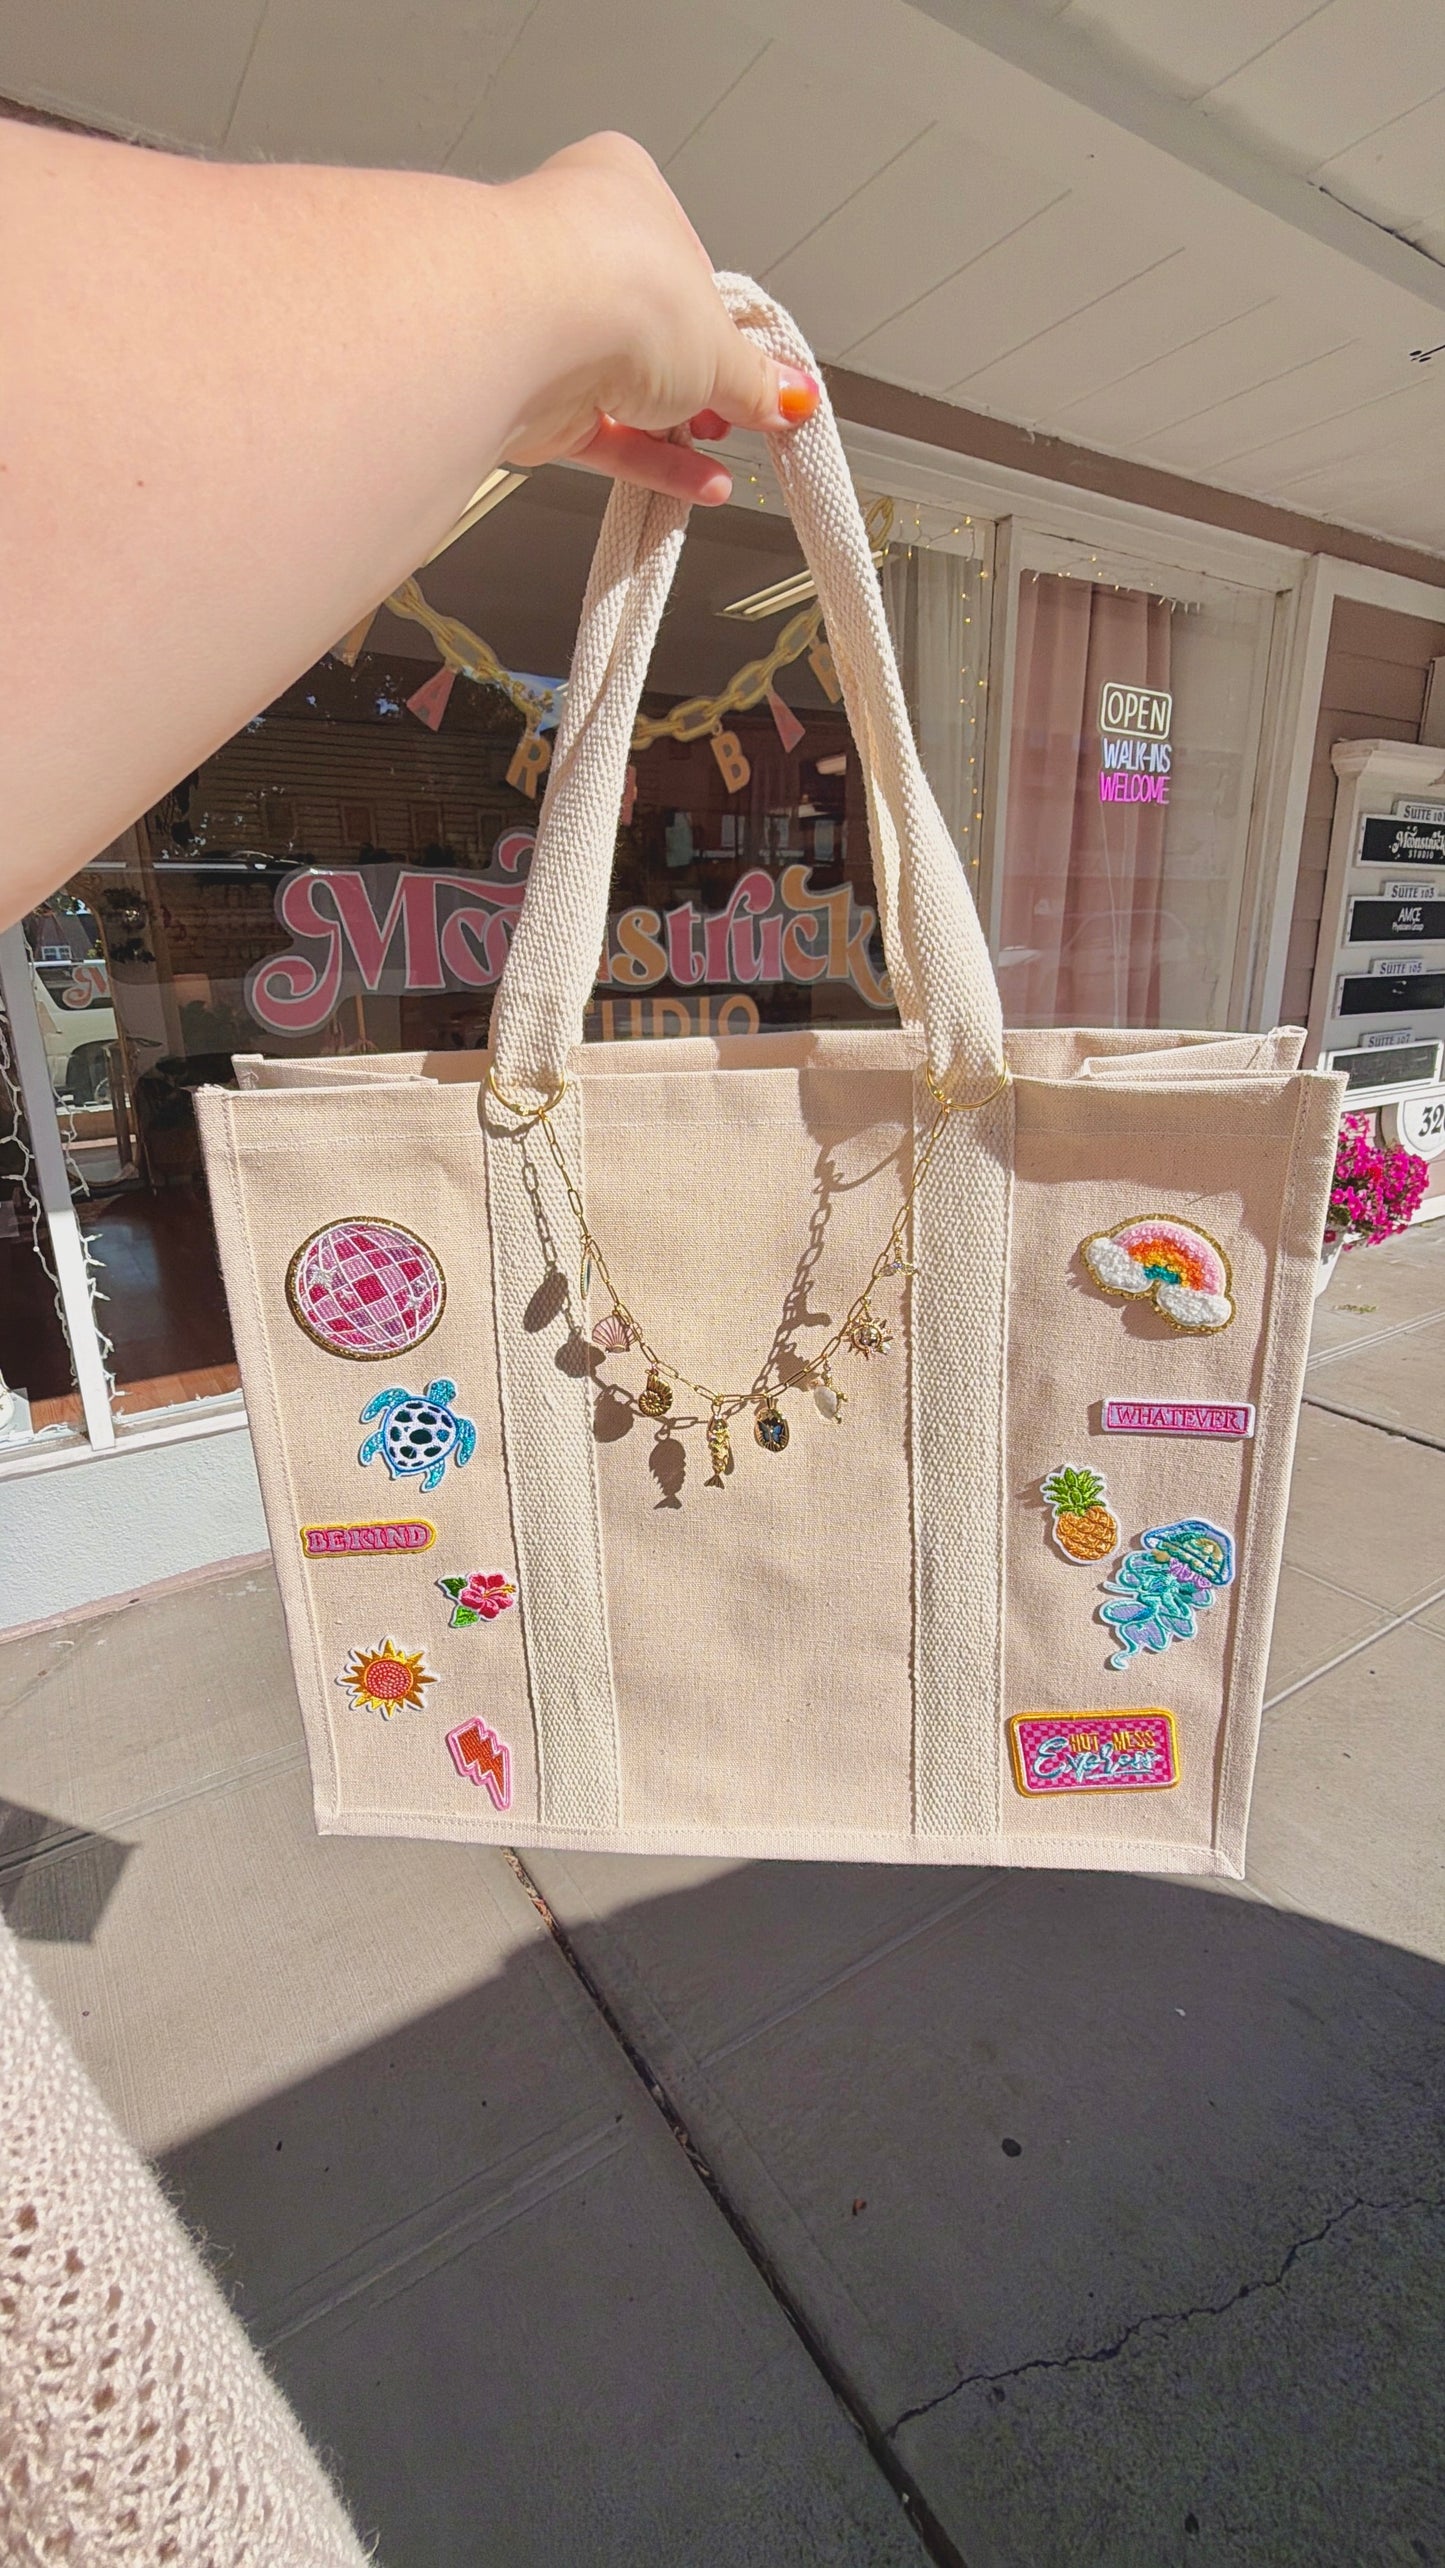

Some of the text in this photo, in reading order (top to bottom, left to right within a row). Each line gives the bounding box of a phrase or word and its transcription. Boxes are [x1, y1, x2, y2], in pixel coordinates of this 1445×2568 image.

[1107, 691, 1167, 732] OPEN
[1103, 737, 1172, 773] WALK-INS
[1100, 771, 1171, 804] WELCOME
[252, 832, 898, 1028] Mostruck
[583, 993, 760, 1041] UDIO
[1418, 1104, 1445, 1137] 32
[1116, 1406, 1241, 1430] WHATEVER
[1069, 1730, 1156, 1752] HOT MESS
[1032, 1736, 1162, 1783] Express
